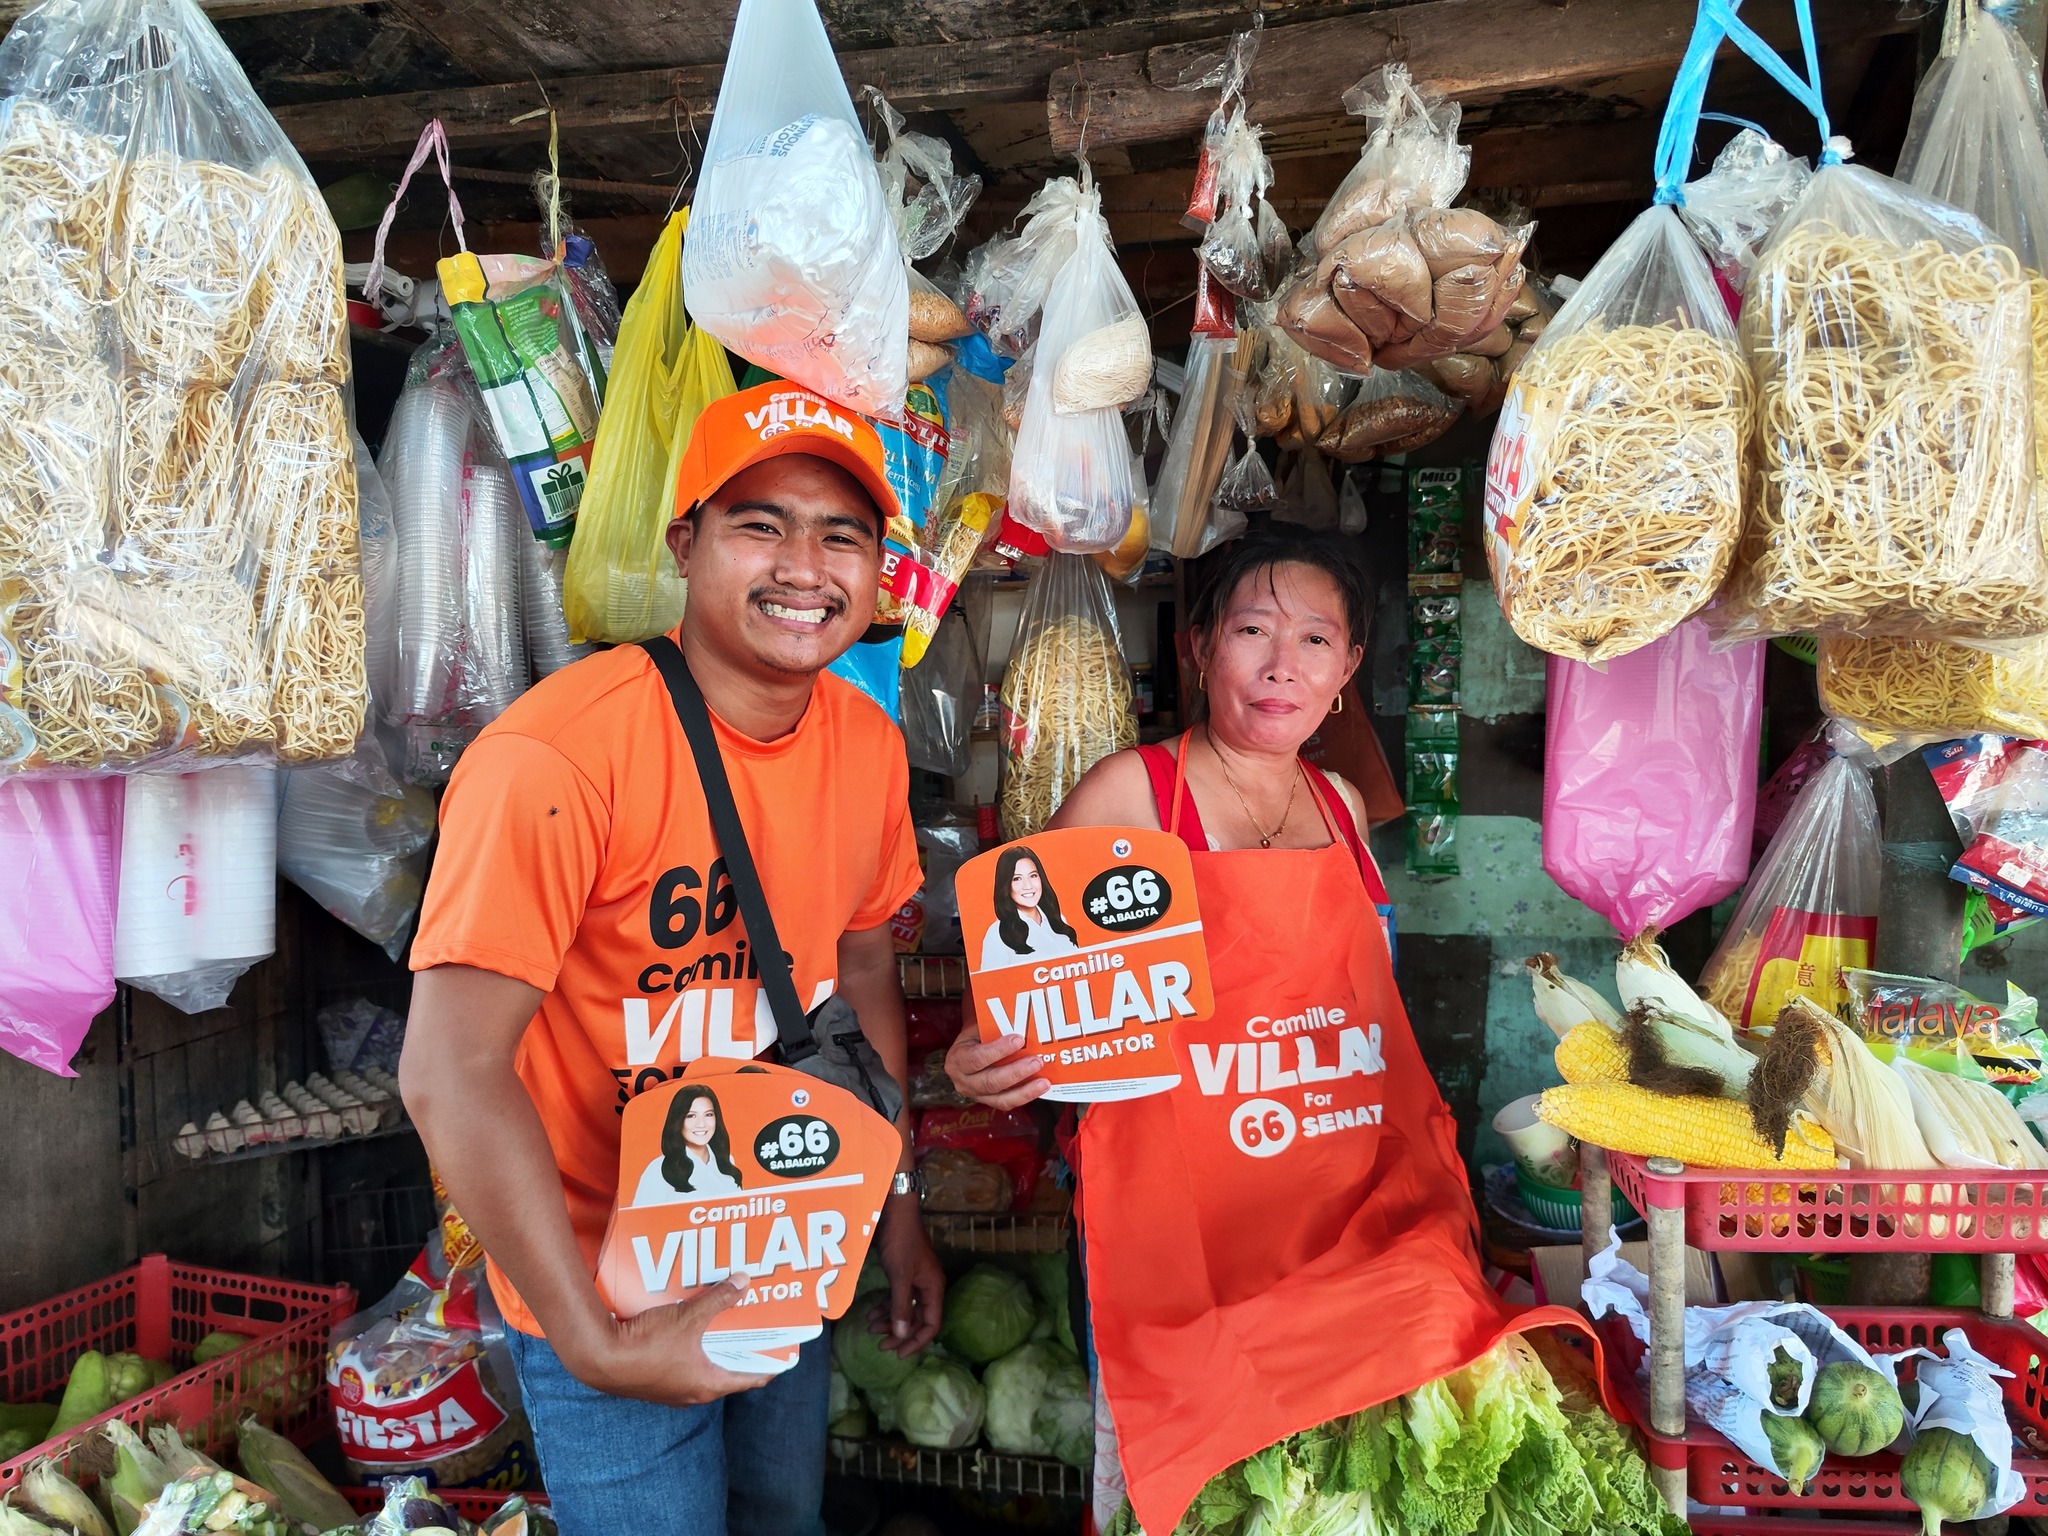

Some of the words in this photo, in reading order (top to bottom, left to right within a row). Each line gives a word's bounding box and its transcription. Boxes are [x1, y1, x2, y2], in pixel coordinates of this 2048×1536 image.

[768, 123, 800, 157] FLOUR
[744, 400, 854, 441] VILLAR
[795, 420, 814, 428] For
[884, 447, 936, 485] REMIUM
[1420, 470, 1457, 484] MILO
[650, 856, 739, 949] 66
[1090, 869, 1161, 915] #66
[2006, 891, 2046, 914] Raisins
[1102, 913, 1117, 925] SA
[1117, 907, 1159, 921] BALOTA
[1033, 952, 1126, 984] Camille
[986, 961, 1198, 1046] VILLAR
[1246, 1006, 1347, 1038] Camille
[1060, 1033, 1155, 1066] SENATOR
[1303, 1092, 1333, 1108] For
[760, 1120, 830, 1160] #66
[1240, 1109, 1285, 1148] 66
[1301, 1104, 1383, 1138] SENAT
[770, 1159, 785, 1170] SA
[785, 1156, 826, 1169] BALOTA
[689, 1196, 786, 1225] Camille
[631, 1210, 847, 1294] VILLAR
[735, 1281, 803, 1308] ATOR
[335, 1397, 478, 1450] FIESTA
